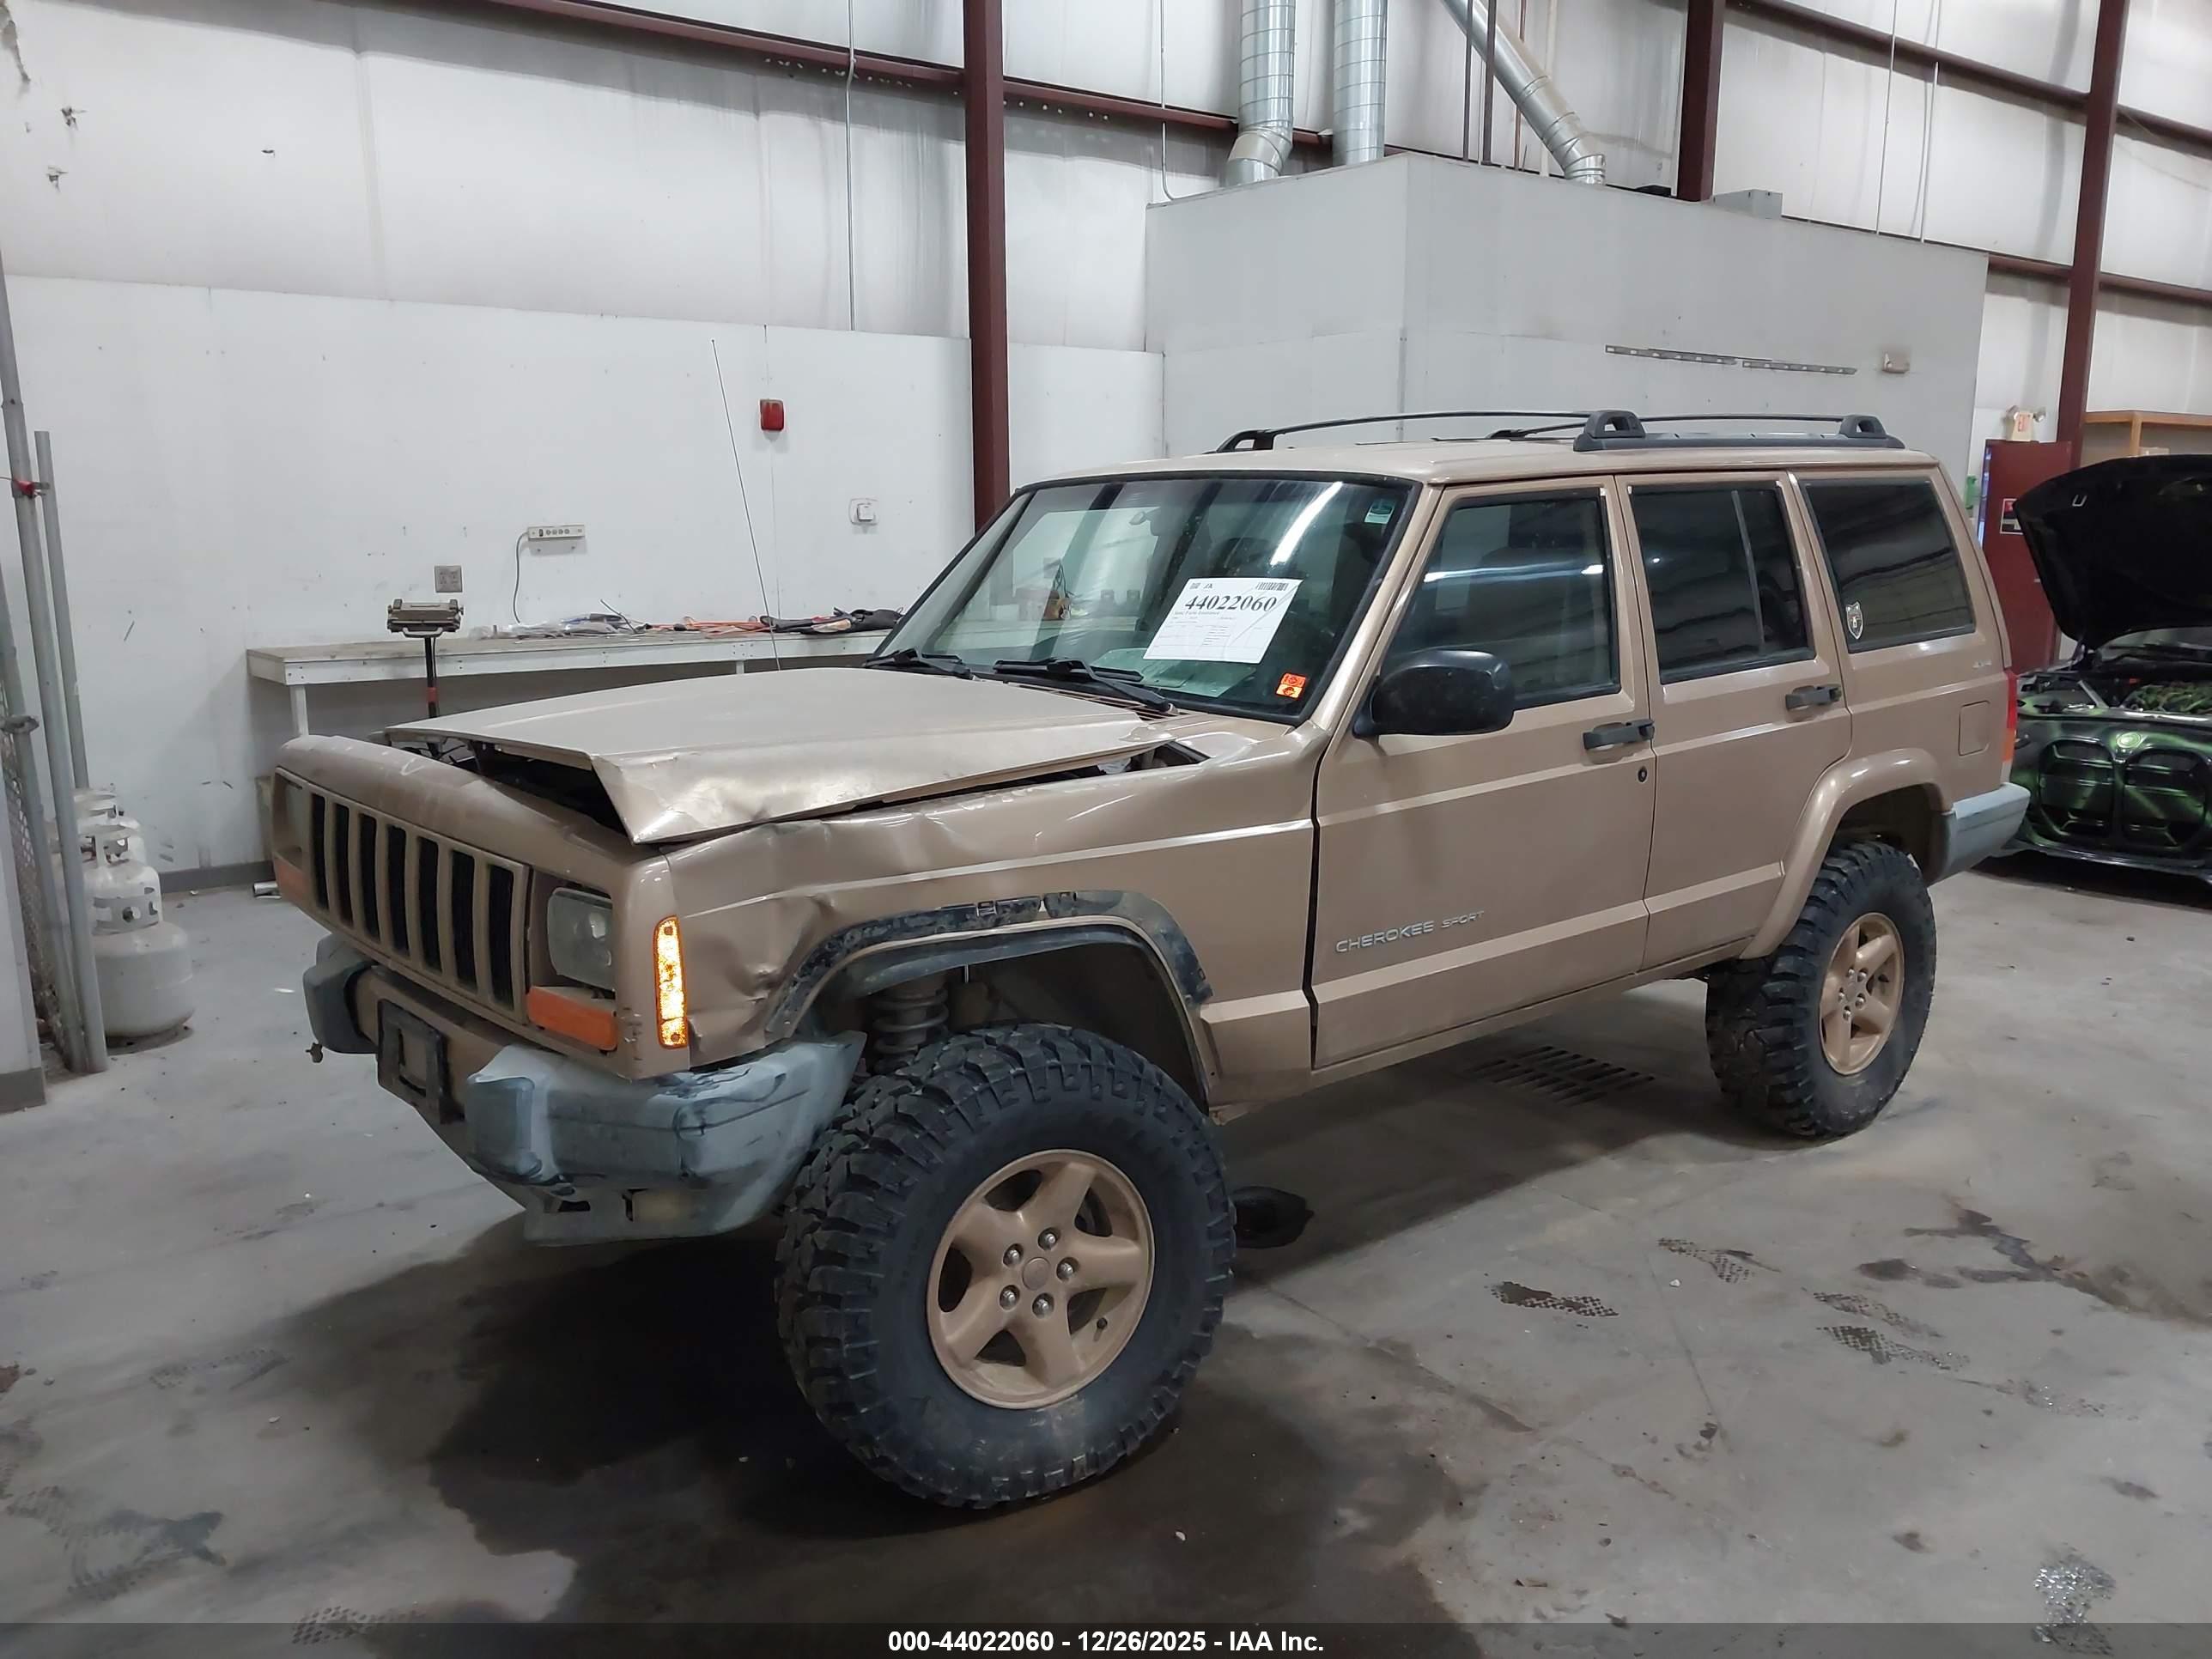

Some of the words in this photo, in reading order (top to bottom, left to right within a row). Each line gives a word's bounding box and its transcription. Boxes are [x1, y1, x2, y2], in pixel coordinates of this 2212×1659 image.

[1185, 595, 1277, 612] 44022060
[1334, 920, 1436, 953] CHEROKEE
[1441, 910, 1485, 928] SPORT
